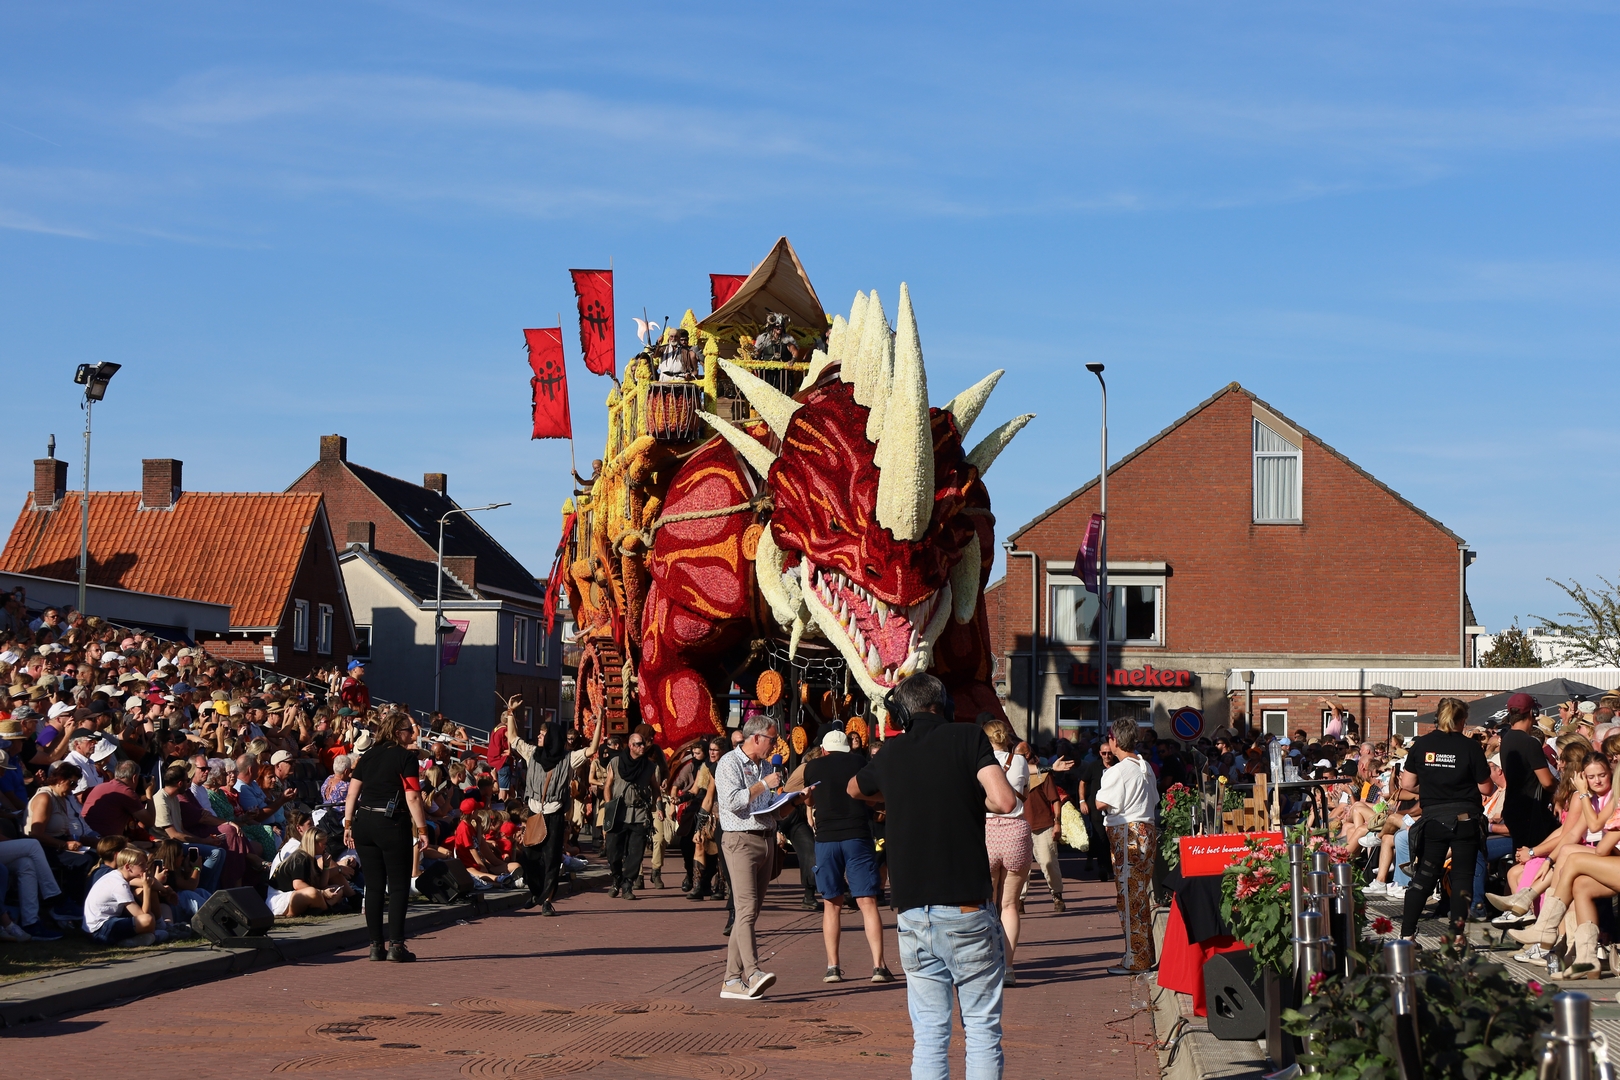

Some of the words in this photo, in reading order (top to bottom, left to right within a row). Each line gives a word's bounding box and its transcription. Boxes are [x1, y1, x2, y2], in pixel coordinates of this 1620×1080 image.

[1071, 663, 1191, 687] Heineken
[1206, 846, 1220, 854] best
[1222, 845, 1249, 853] bewaarde
